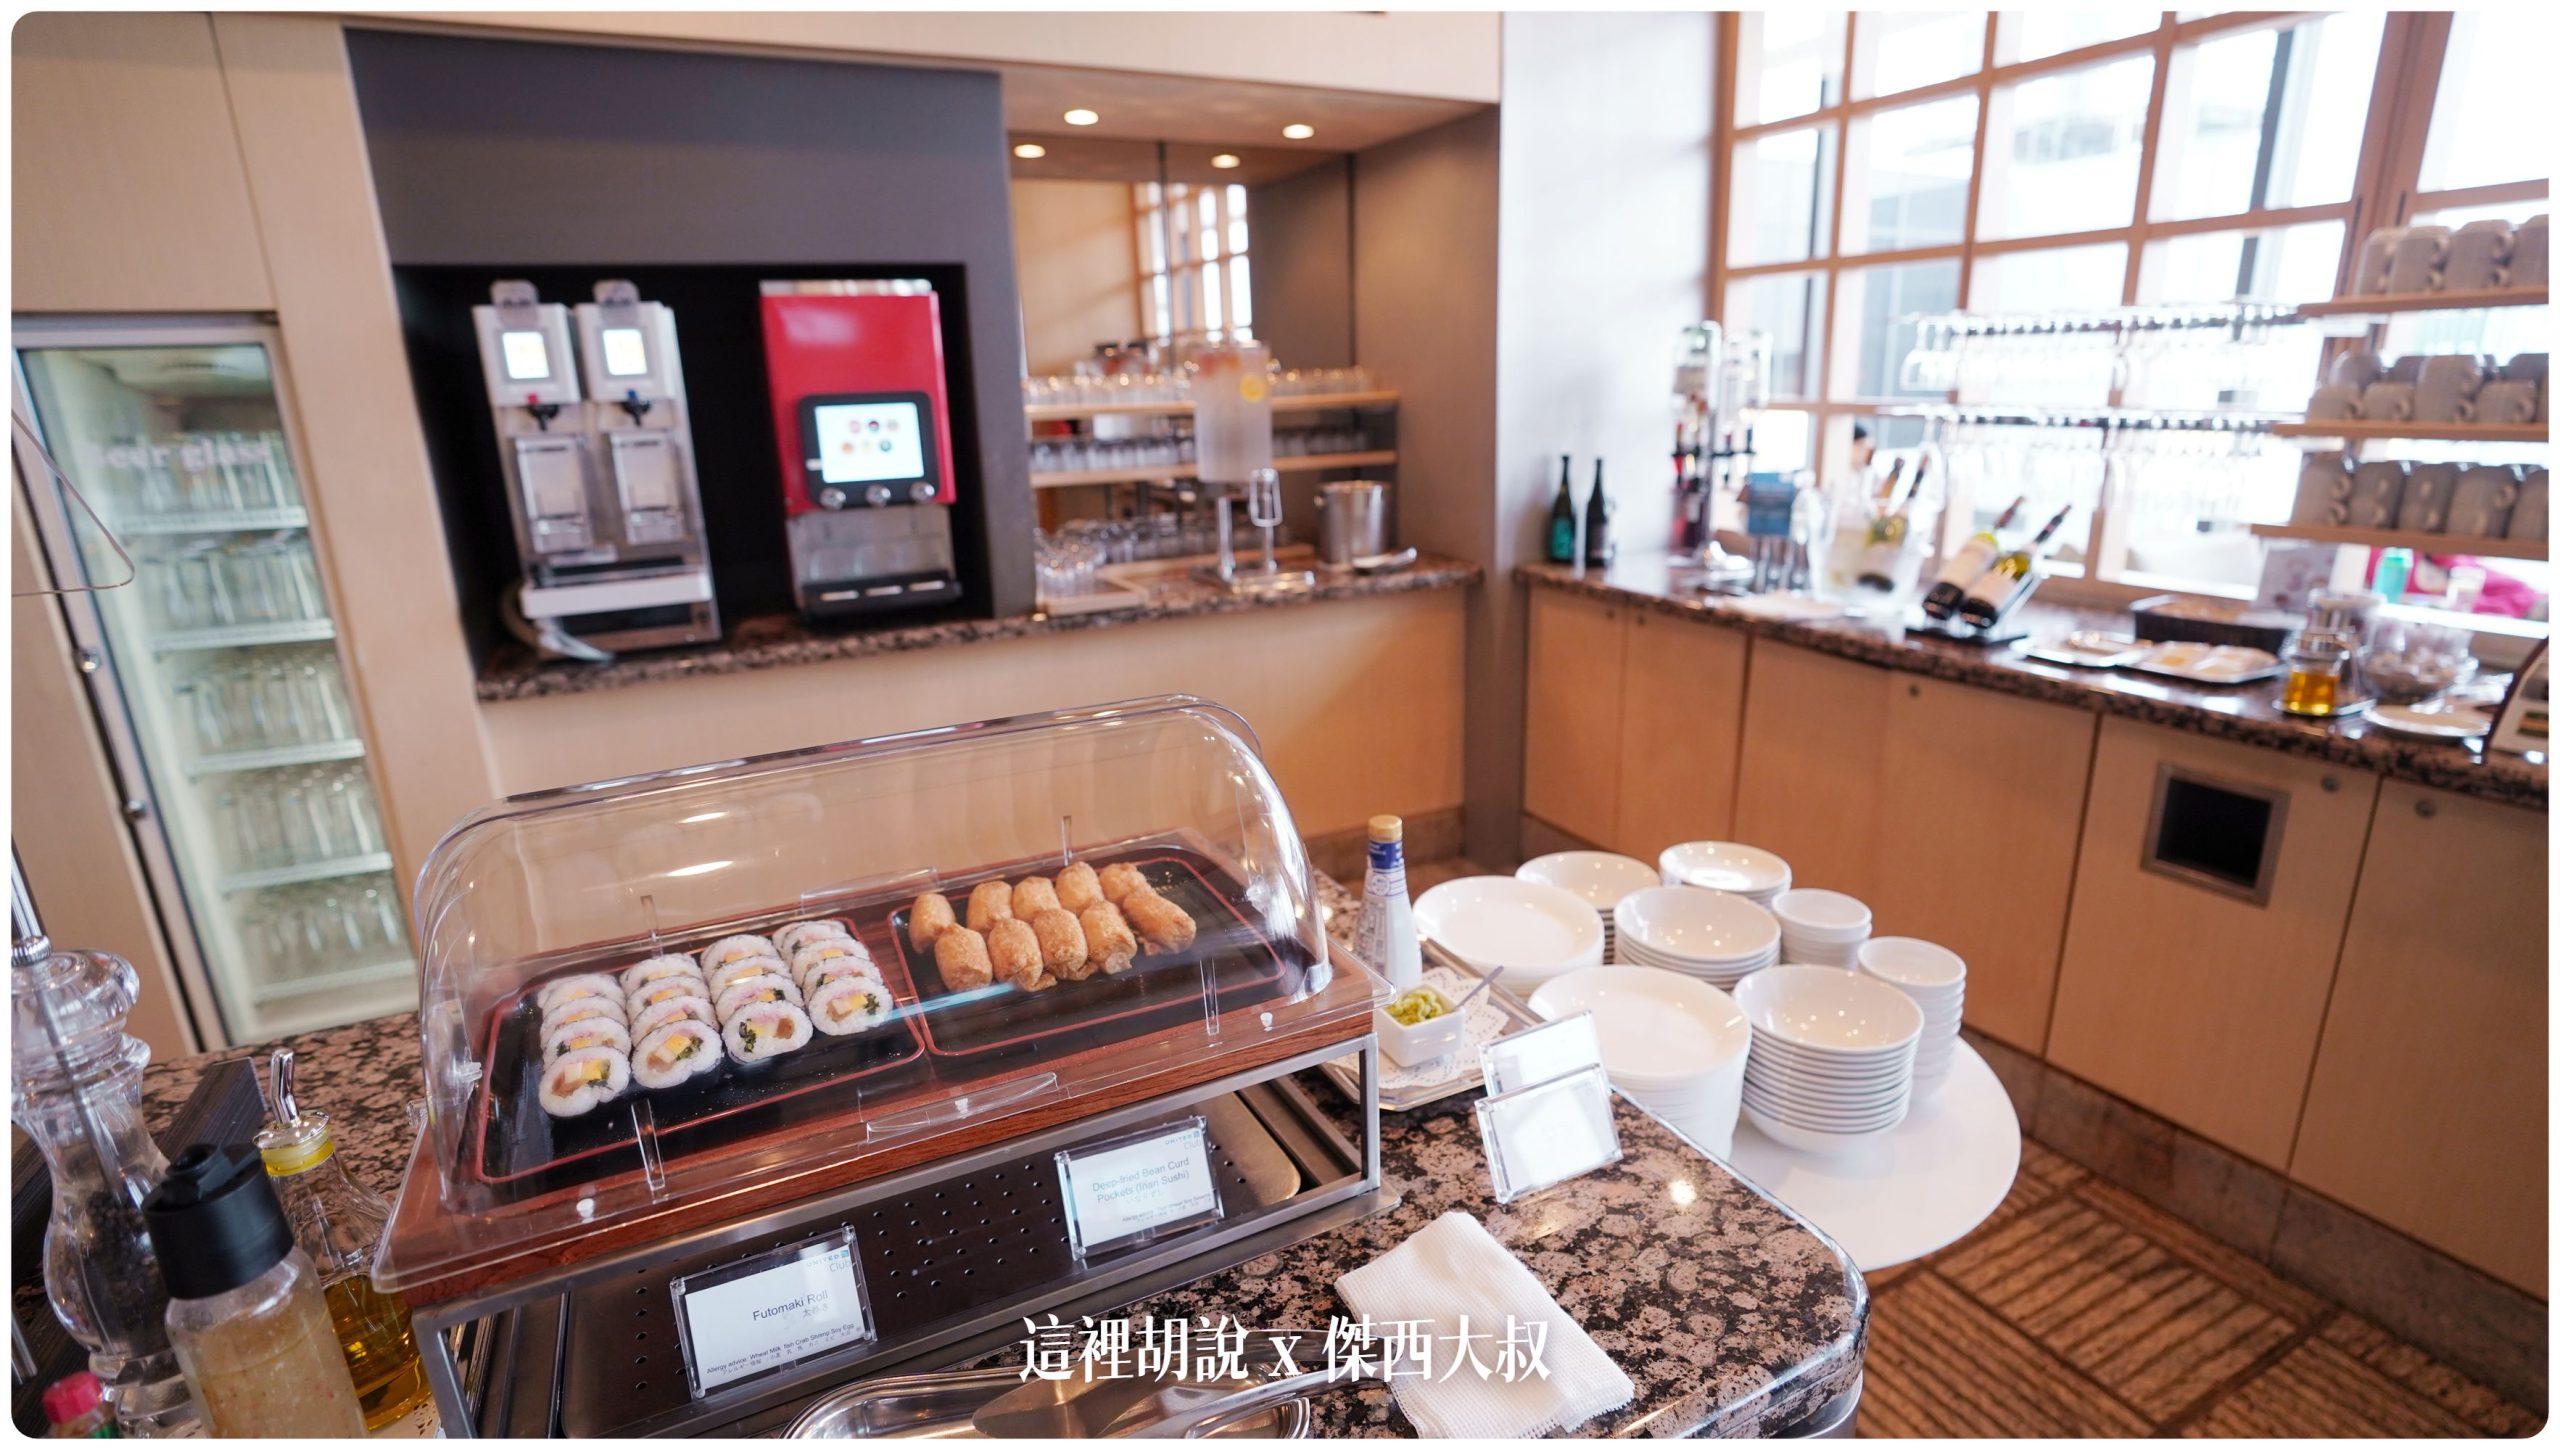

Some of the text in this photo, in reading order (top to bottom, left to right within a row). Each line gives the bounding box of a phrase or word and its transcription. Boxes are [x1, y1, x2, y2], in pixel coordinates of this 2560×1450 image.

[1092, 1157, 1190, 1192] Deep-fried Bean Curd
[1097, 1187, 1134, 1204] Pockets
[1161, 1171, 1190, 1186] Sushi)
[830, 1260, 851, 1273] Club
[752, 1290, 829, 1321] Futomaki Roll
[706, 1362, 727, 1374] Allergy
[749, 1350, 769, 1360] Wheat
[769, 1346, 781, 1355] Milk
[795, 1337, 809, 1346] Crab
[810, 1330, 830, 1341] Shrimp
